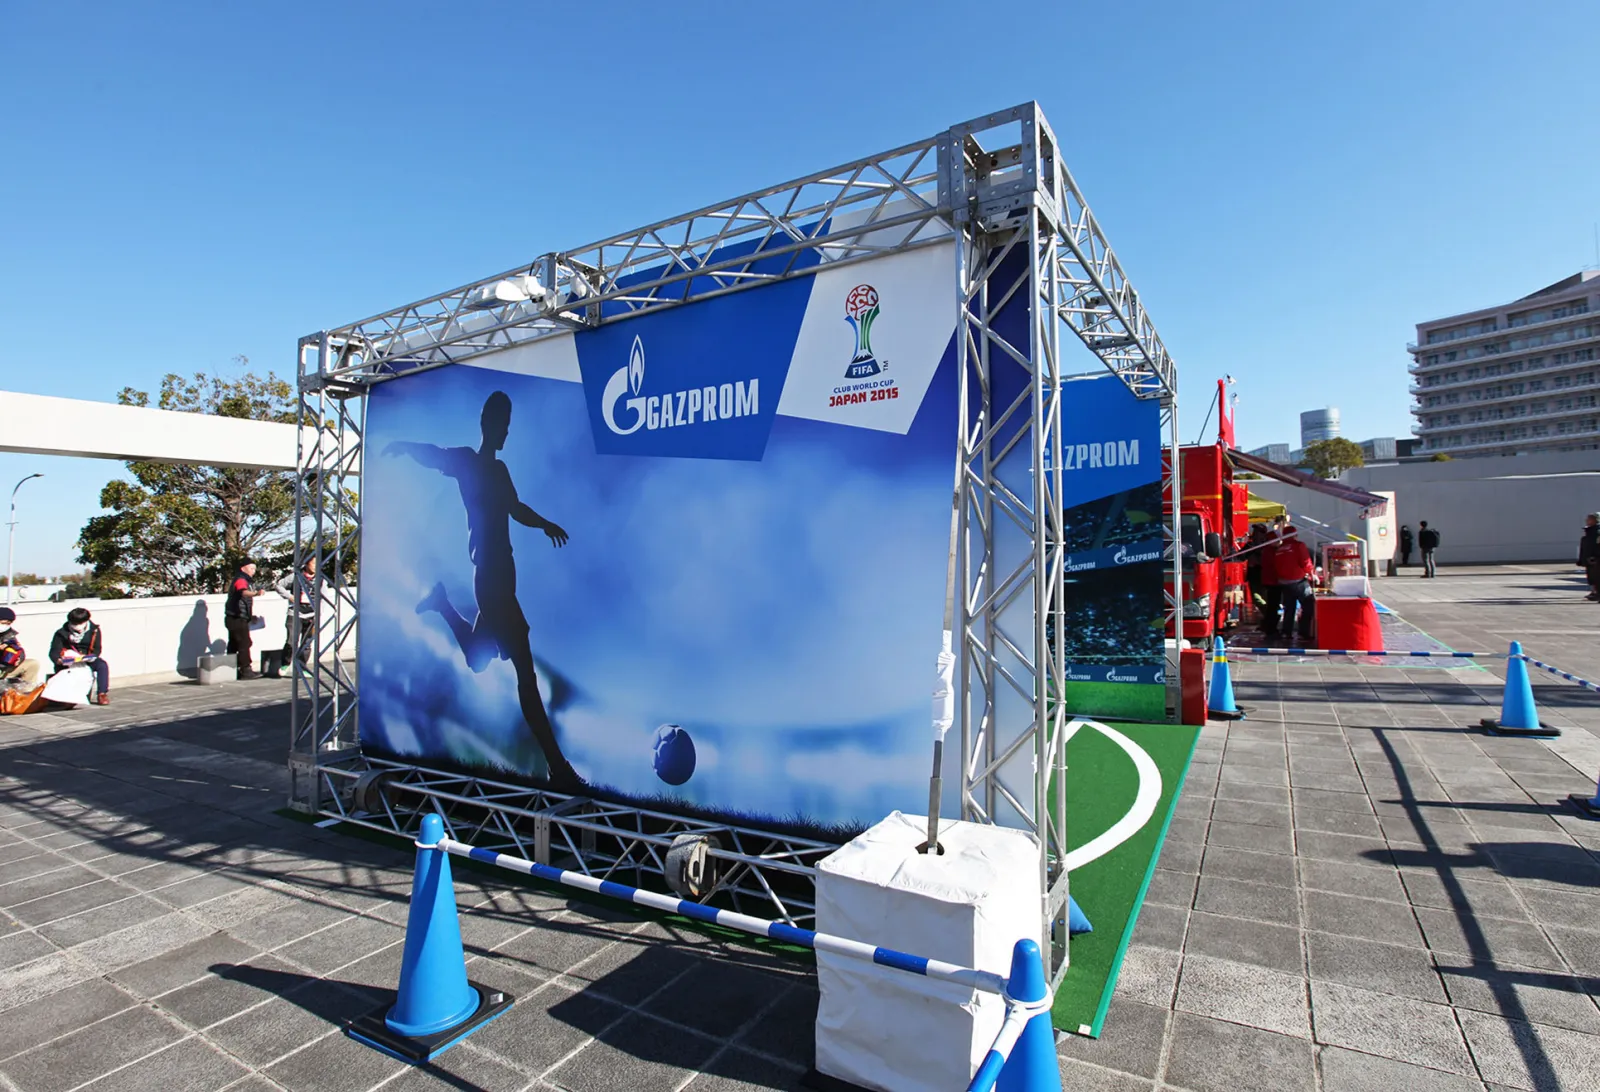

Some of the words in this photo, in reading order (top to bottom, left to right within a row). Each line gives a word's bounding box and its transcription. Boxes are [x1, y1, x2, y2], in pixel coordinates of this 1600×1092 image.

[852, 365, 873, 376] FIFA
[833, 385, 851, 394] CLUB
[852, 381, 879, 391] WORLD
[879, 379, 895, 387] CUP
[646, 378, 759, 430] GAZPROM
[829, 391, 867, 407] JAPAN
[870, 387, 899, 402] 2015
